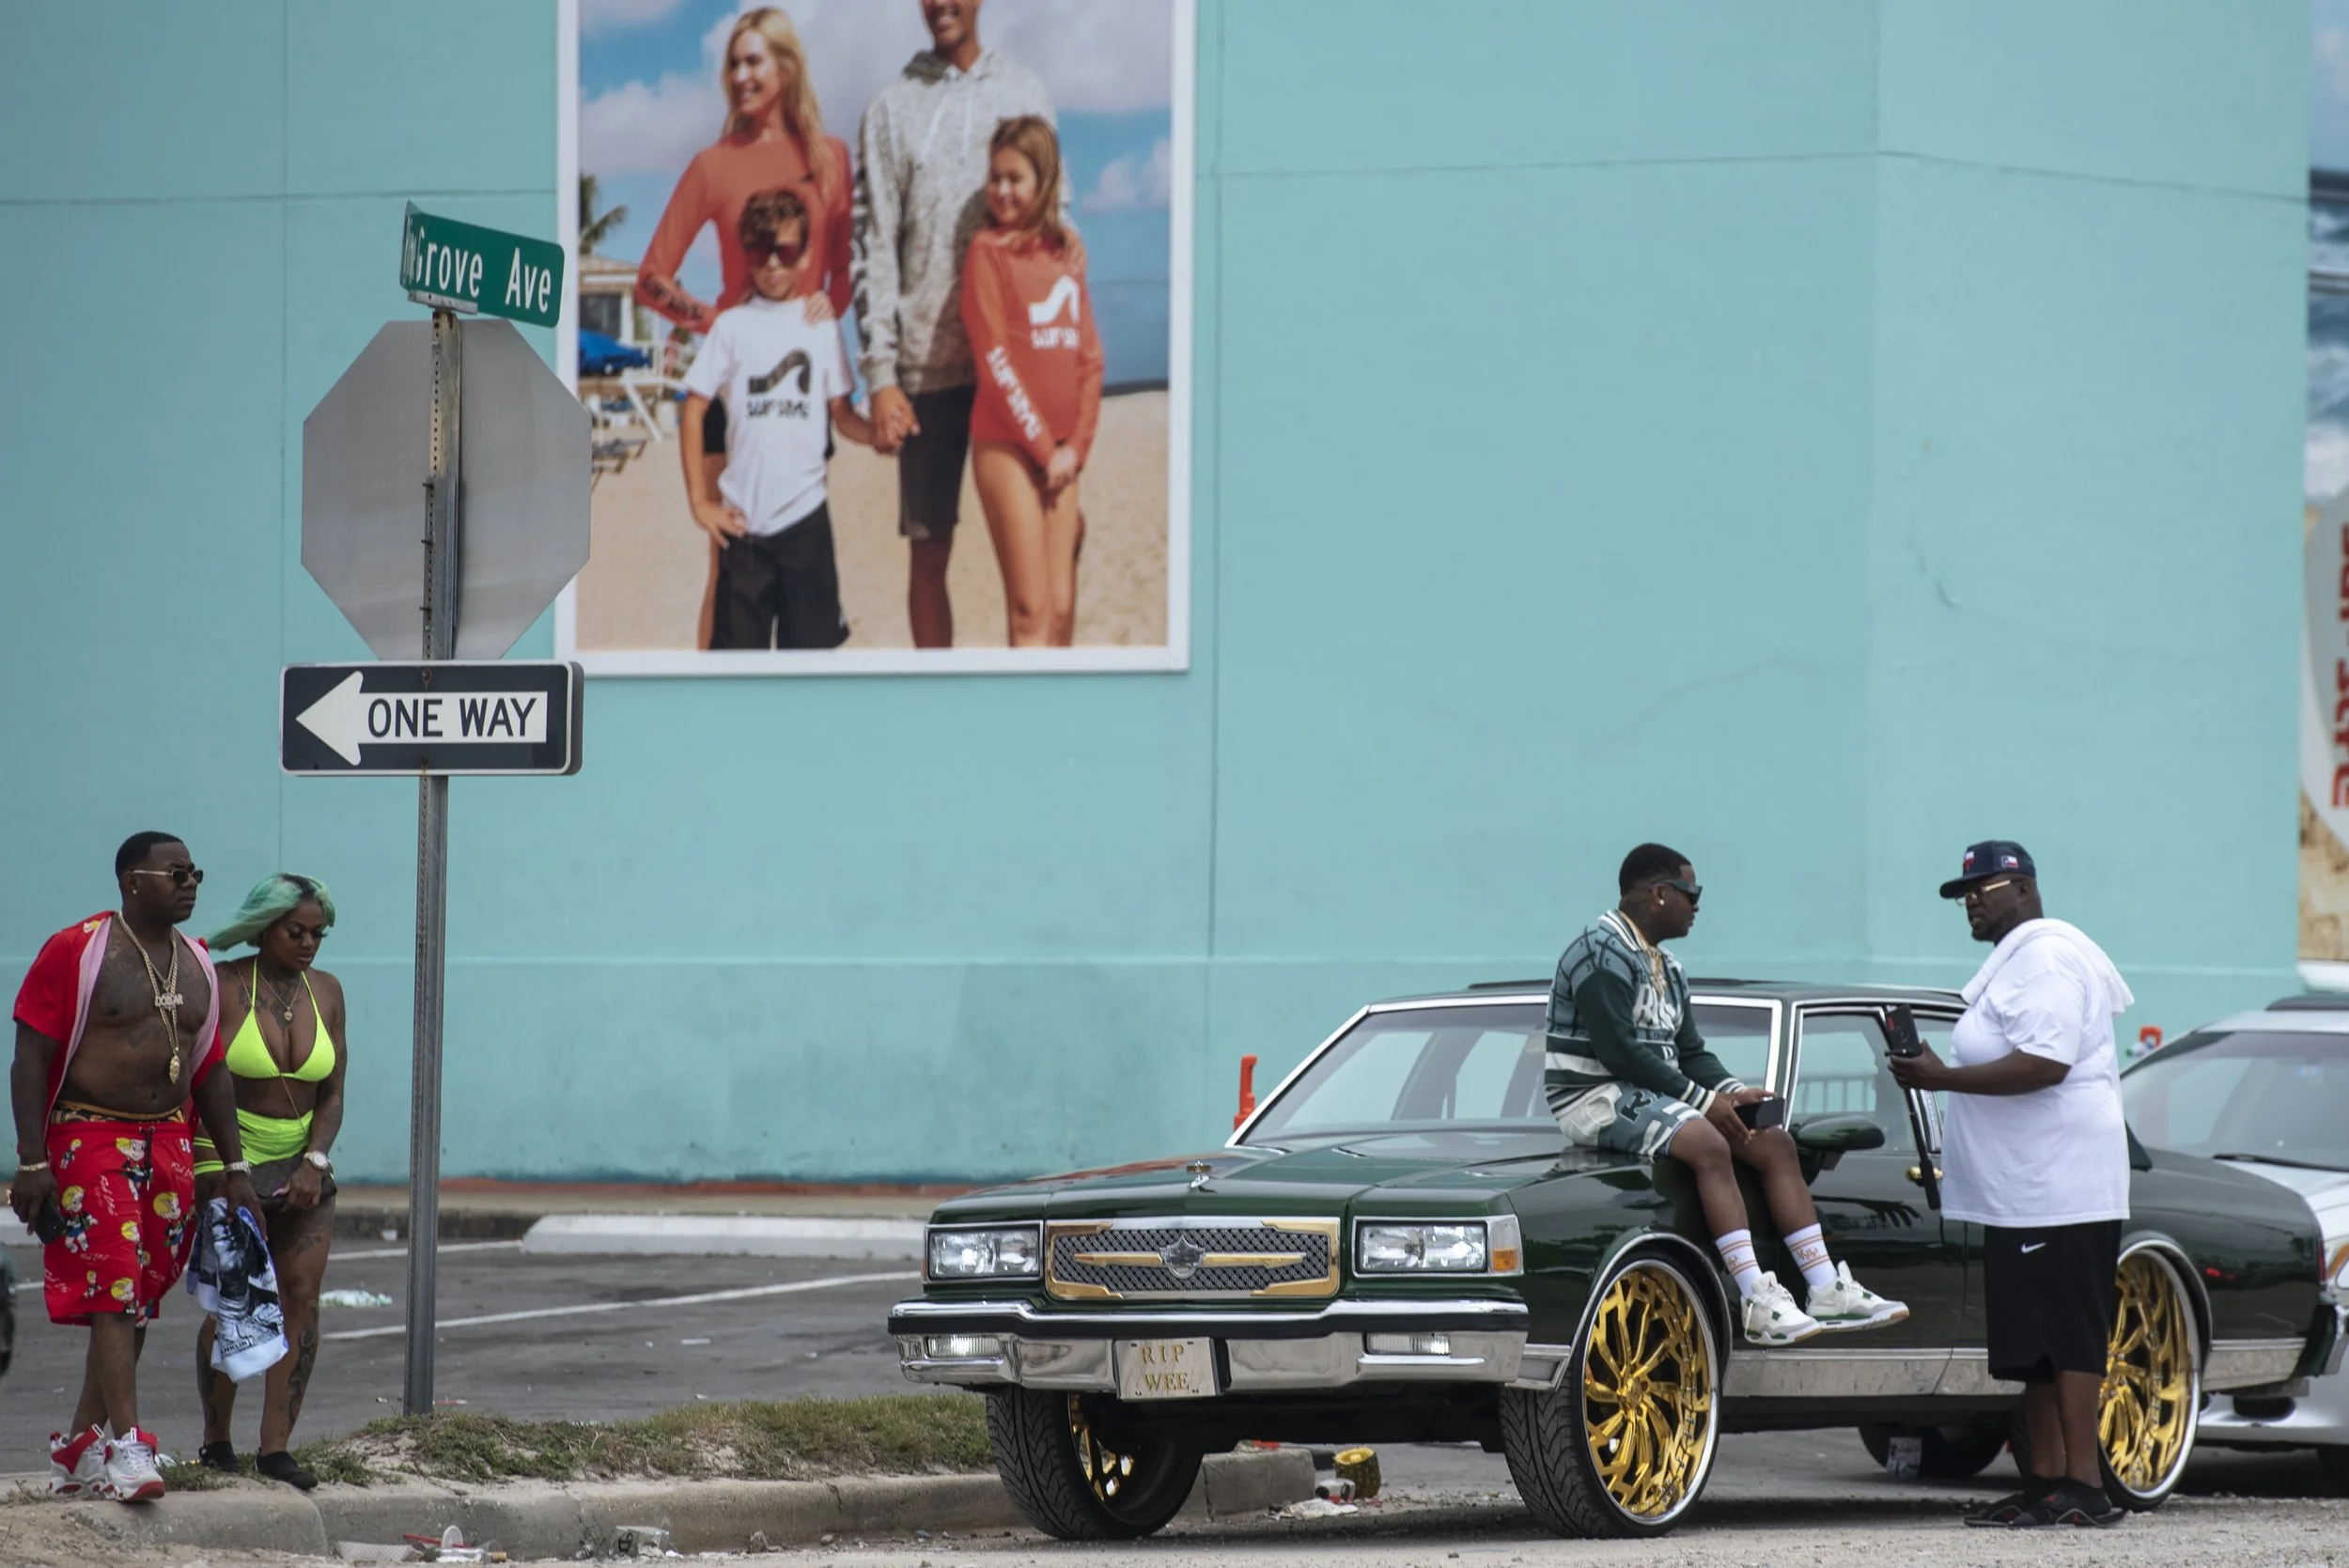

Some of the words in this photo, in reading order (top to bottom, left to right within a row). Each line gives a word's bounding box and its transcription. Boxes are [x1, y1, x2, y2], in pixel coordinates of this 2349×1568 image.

[505, 247, 552, 313] Ave
[367, 698, 443, 737] ONE
[459, 698, 537, 737] WAY
[1140, 1344, 1185, 1364] RIP
[1143, 1373, 1190, 1390] WEE
